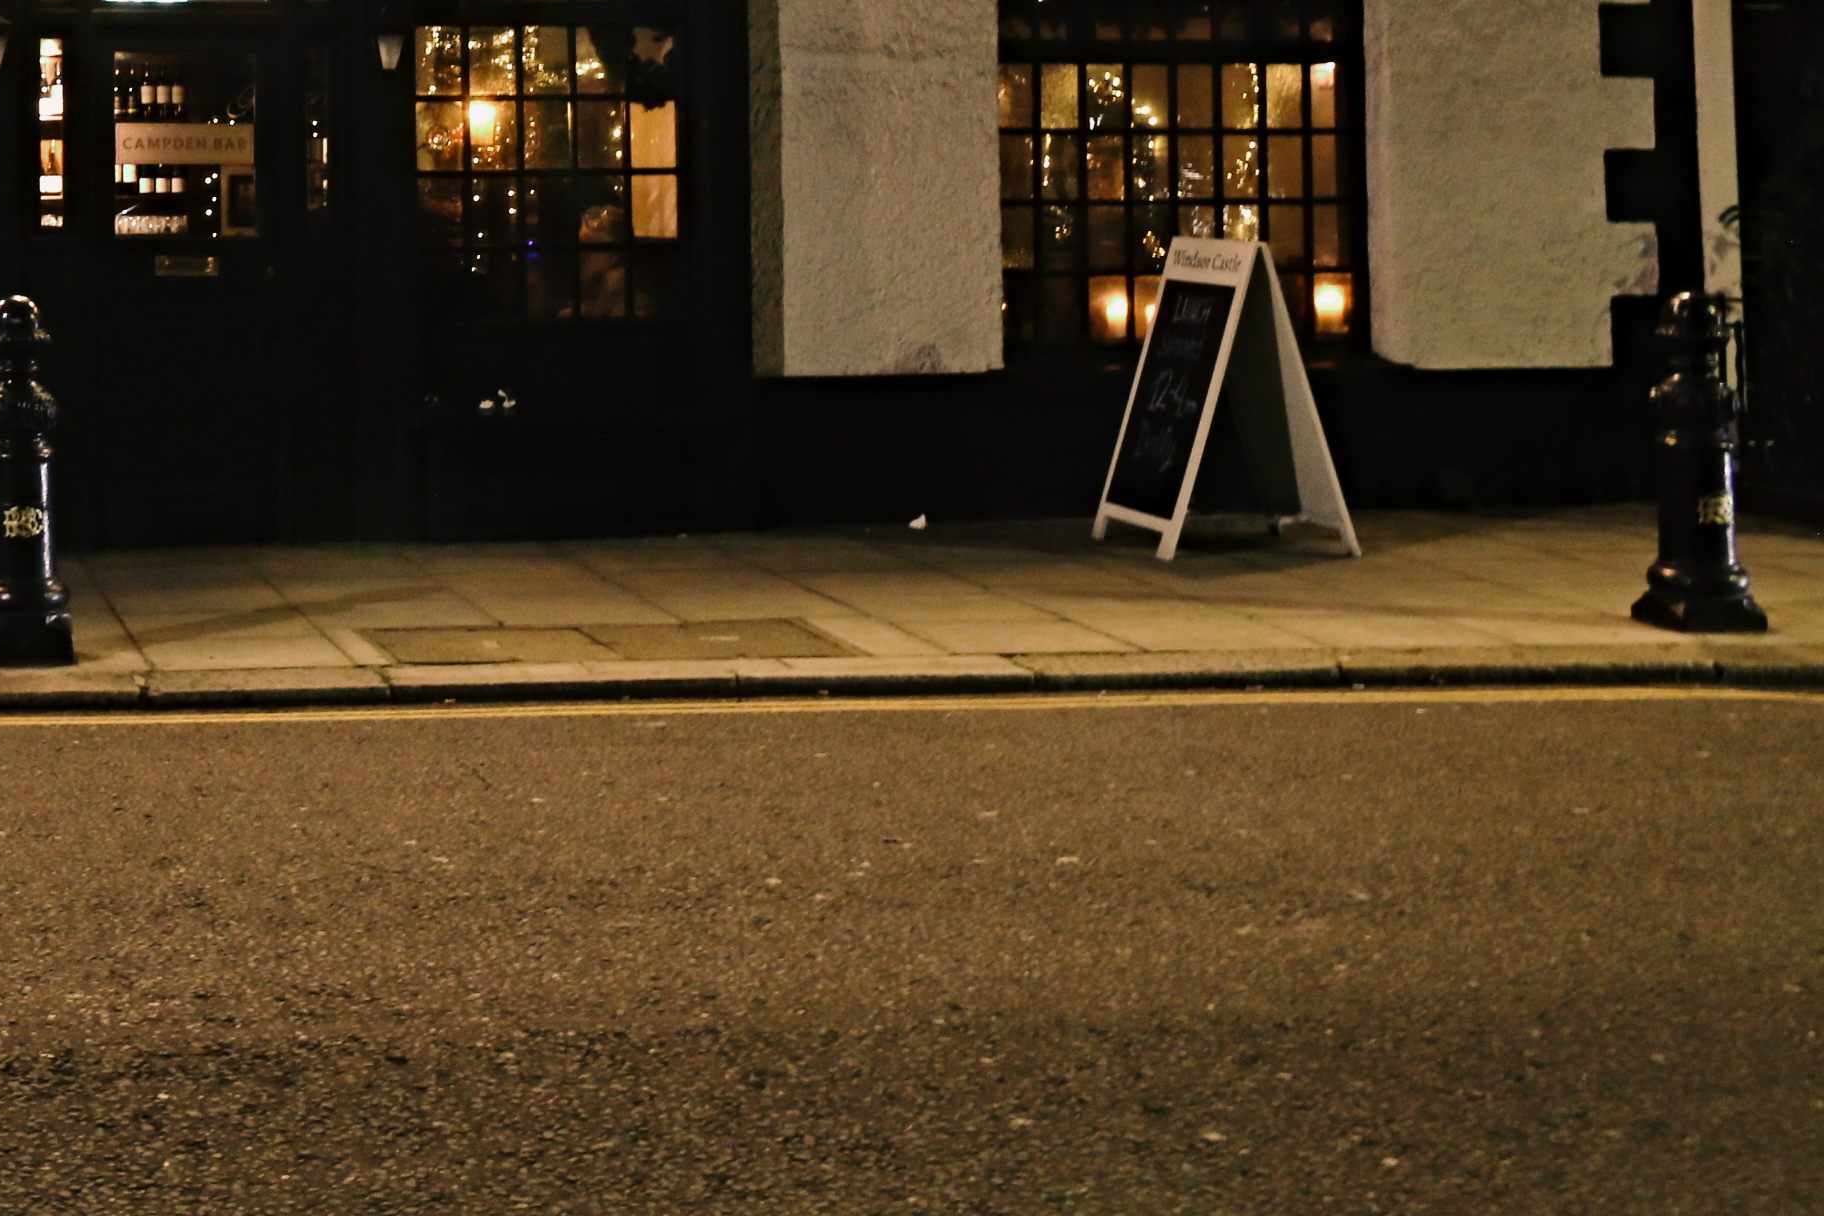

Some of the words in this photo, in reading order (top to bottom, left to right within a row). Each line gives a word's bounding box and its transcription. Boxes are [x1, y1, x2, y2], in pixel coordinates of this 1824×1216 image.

[122, 137, 207, 150] CAMPDEN
[213, 137, 246, 150] BAR
[1173, 249, 1211, 269] Windsor
[1212, 252, 1242, 272] Castle
